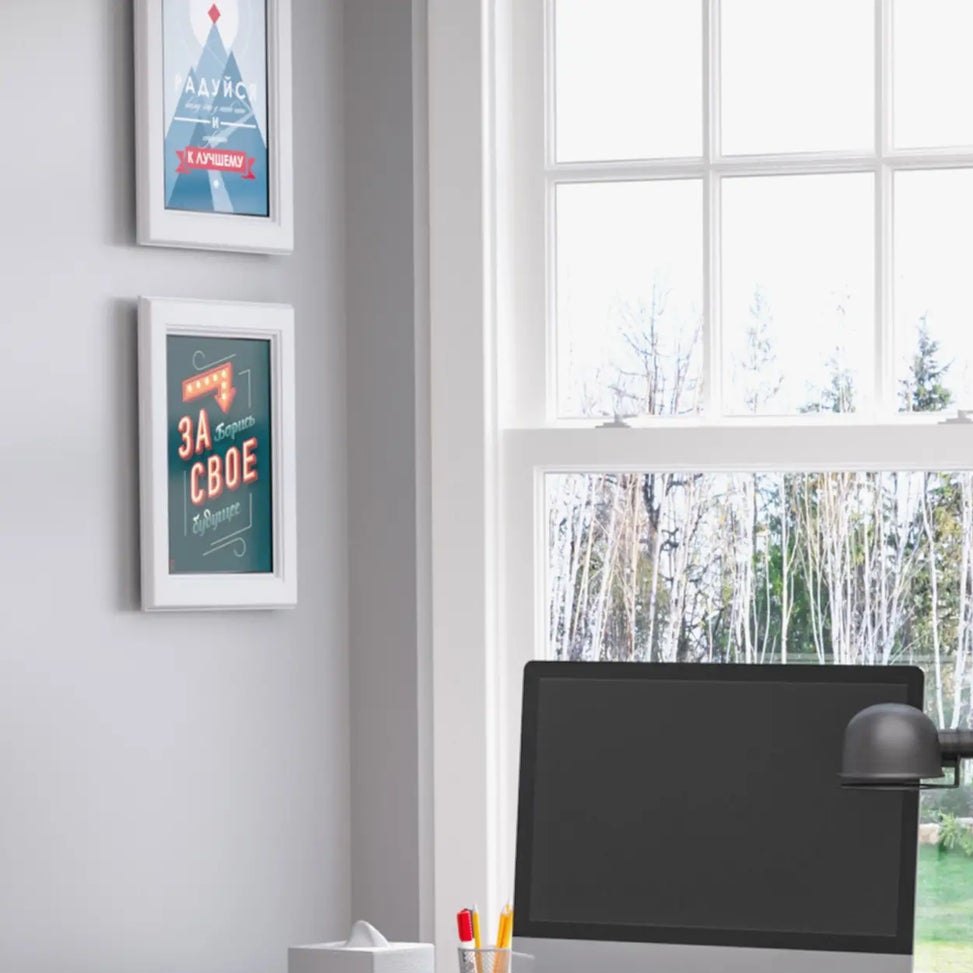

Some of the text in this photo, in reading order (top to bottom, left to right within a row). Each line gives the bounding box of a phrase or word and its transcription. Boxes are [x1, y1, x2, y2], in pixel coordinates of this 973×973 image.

[187, 150, 244, 169] К ЛУЧШЕМУ
[177, 408, 212, 460] ЗА
[189, 437, 259, 506] СВОЕ
